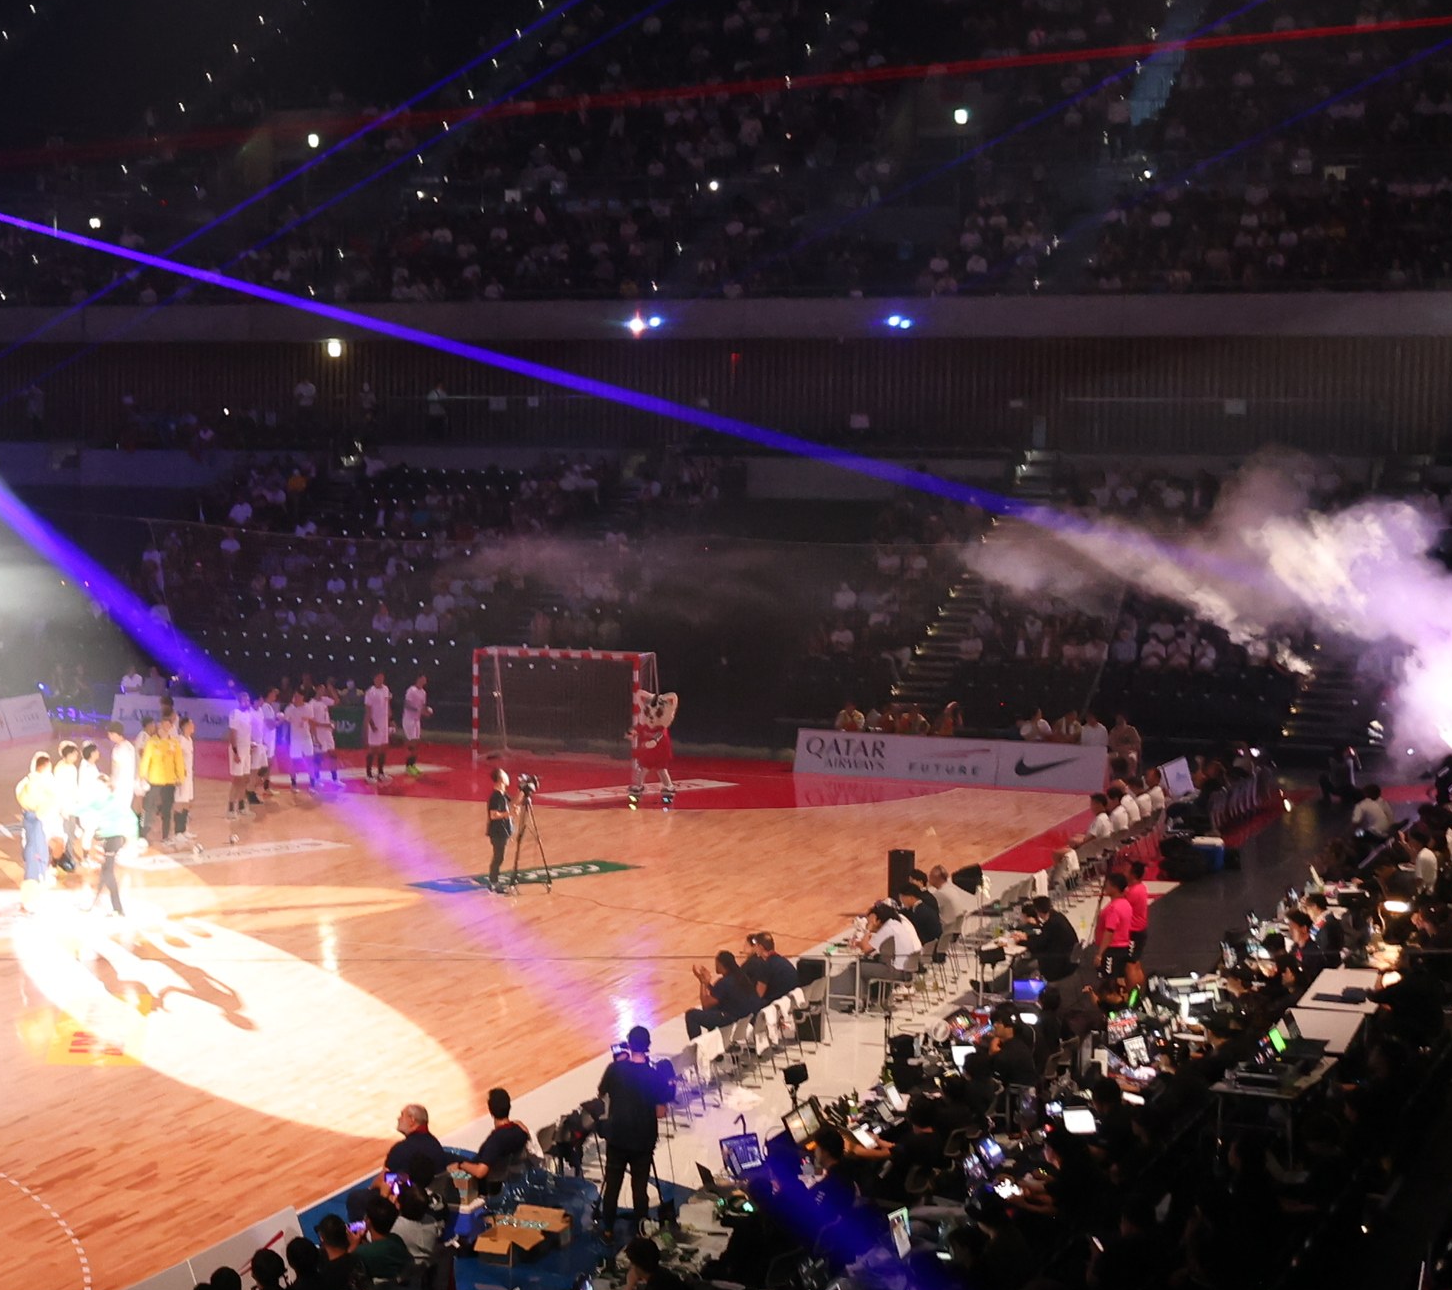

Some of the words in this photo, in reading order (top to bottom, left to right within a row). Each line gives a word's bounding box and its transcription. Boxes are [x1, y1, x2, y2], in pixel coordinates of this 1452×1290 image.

[805, 735, 886, 760] QATAR
[823, 756, 886, 772] AIRWAYS
[908, 761, 981, 777] FUTURE
